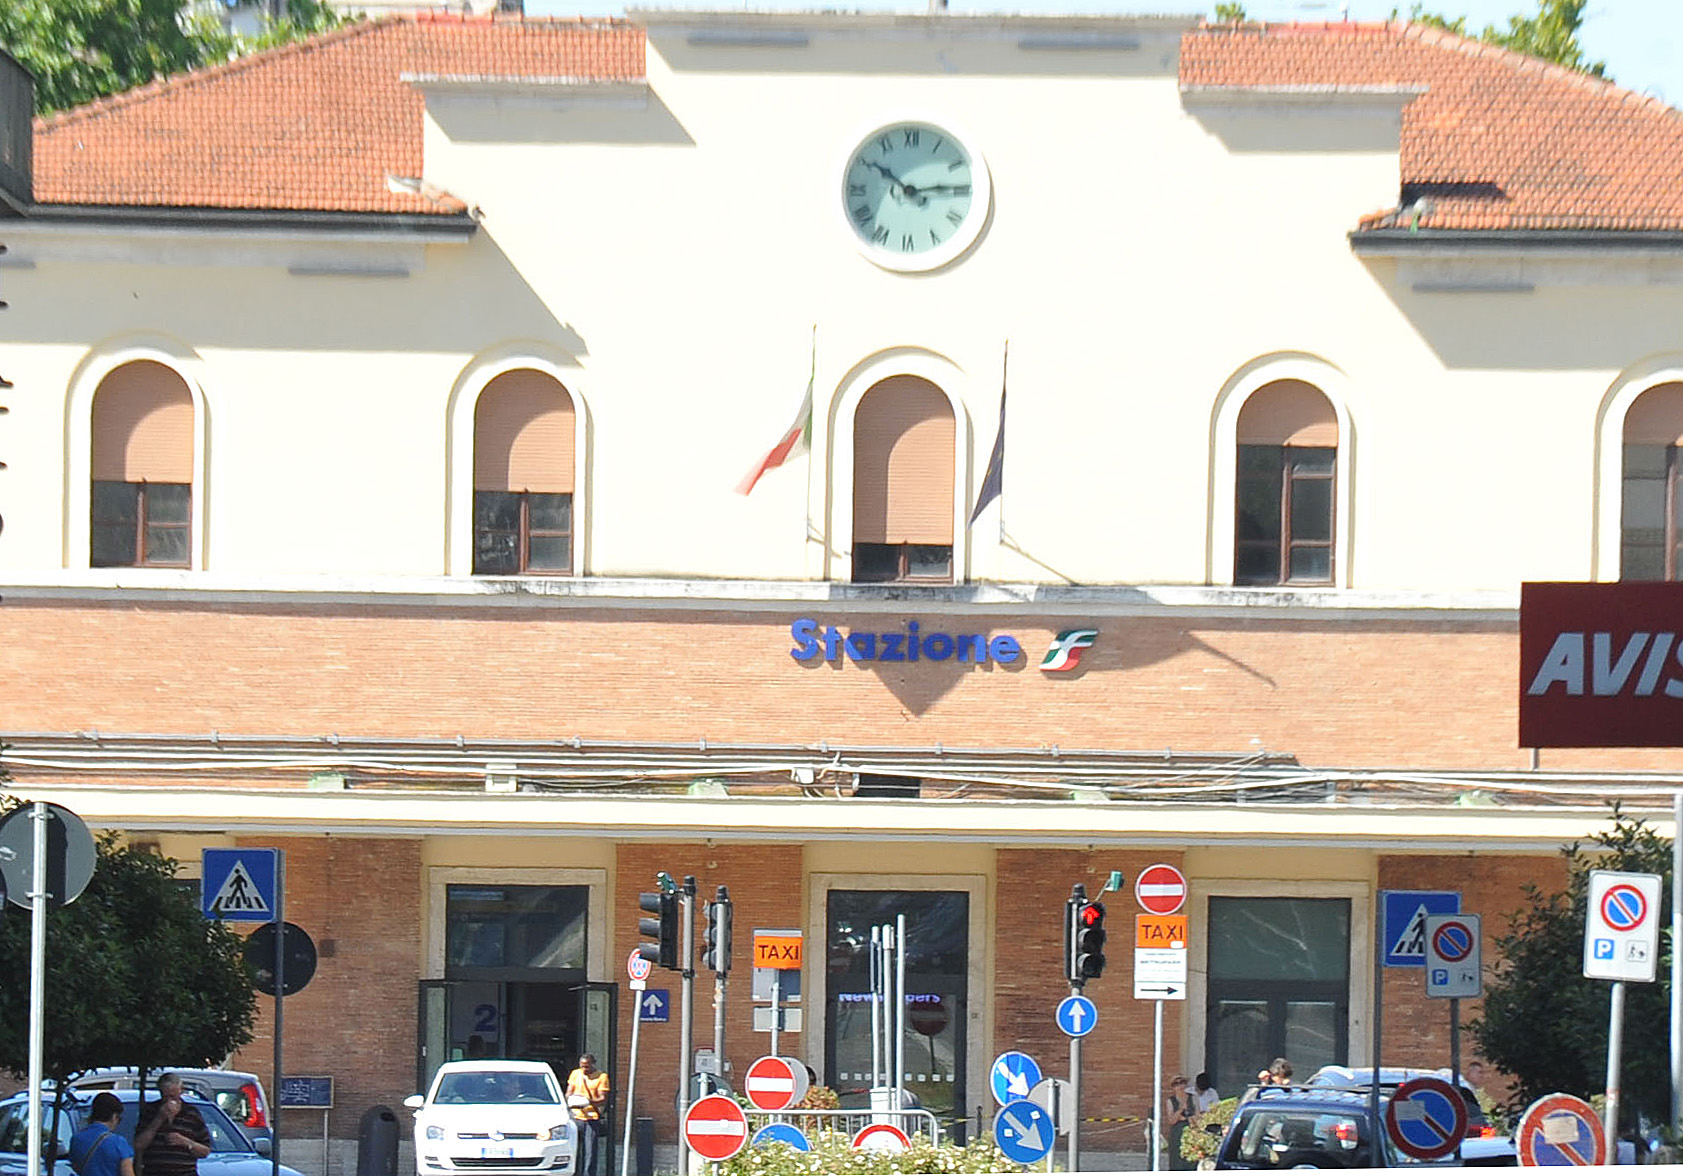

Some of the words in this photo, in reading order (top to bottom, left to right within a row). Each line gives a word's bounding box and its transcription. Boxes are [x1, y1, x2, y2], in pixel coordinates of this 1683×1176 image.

[790, 618, 1020, 663] Stazione
[1141, 924, 1183, 940] TAXI
[758, 944, 799, 960] TAXI
[474, 1004, 497, 1032] 2
